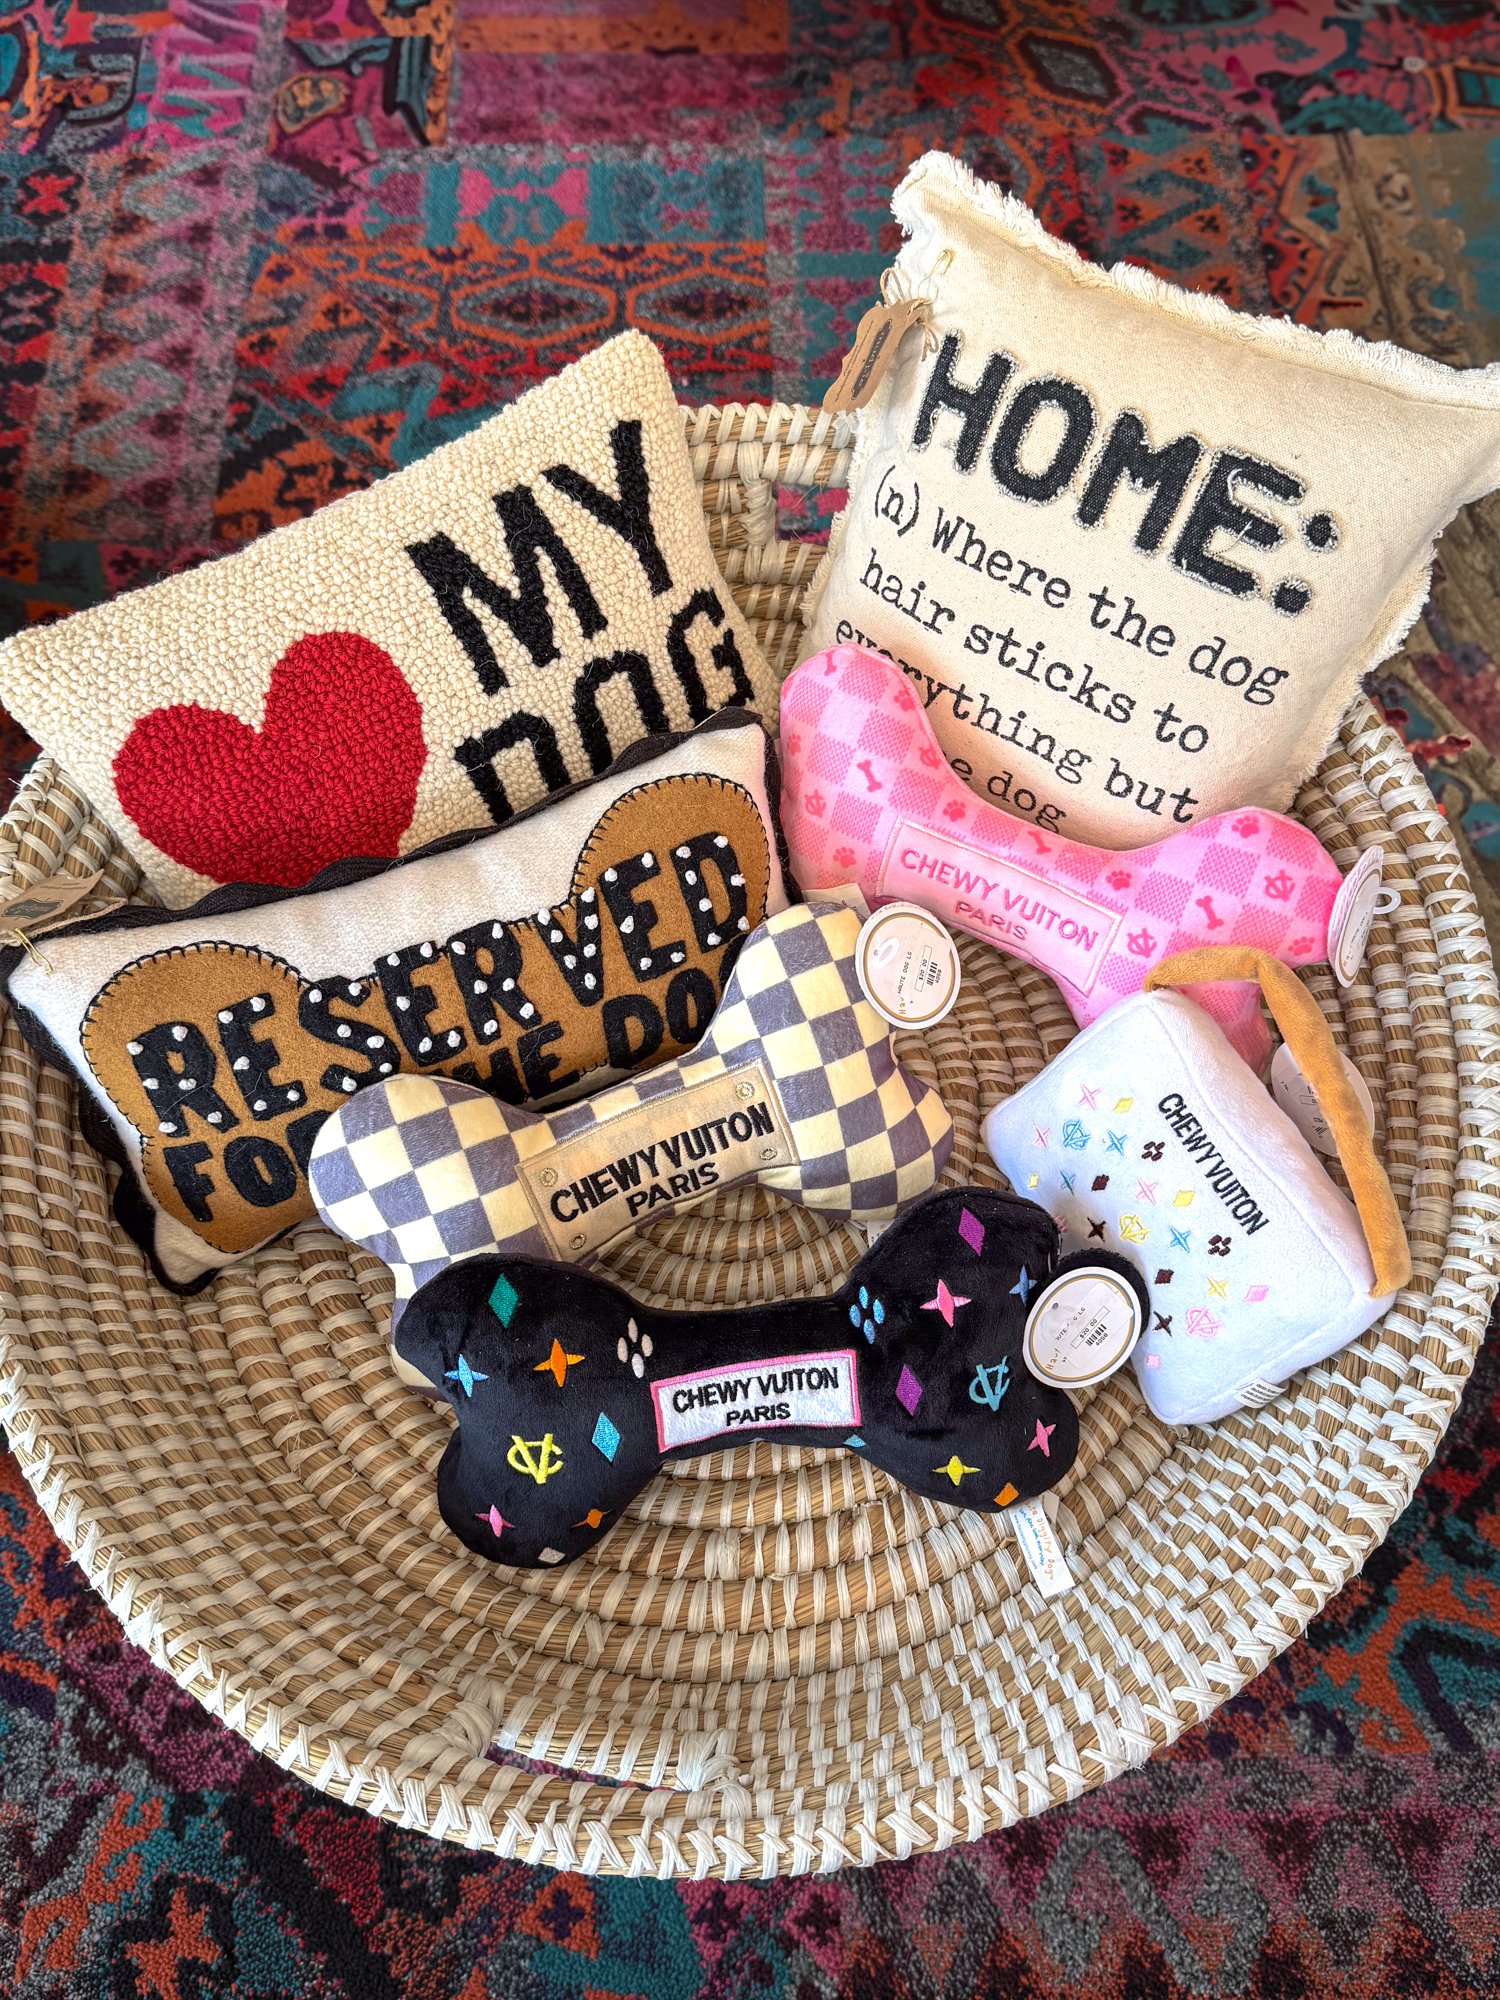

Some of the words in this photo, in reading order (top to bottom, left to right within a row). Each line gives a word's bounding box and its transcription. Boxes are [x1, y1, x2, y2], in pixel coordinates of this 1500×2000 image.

[910, 328, 1341, 617] HOME:
[404, 419, 673, 696] MY
[874, 464, 920, 537] (n)
[930, 506, 1071, 610] Where
[1088, 586, 1176, 657] the
[1188, 635, 1290, 706] dog
[859, 548, 955, 635] hair
[963, 623, 1137, 724] sticks
[1153, 702, 1210, 753] to
[987, 770, 1067, 835] dog
[1103, 757, 1200, 824] but
[900, 847, 1000, 901] CHEWY
[1003, 888, 1100, 952] VUITON
[954, 900, 1028, 941] PARIS
[127, 833, 750, 1139] RESERVED
[425, 1020, 581, 1101] HE
[602, 930, 742, 1070] DO
[625, 1162, 720, 1218] PARIS
[672, 1377, 751, 1414] CHEWY
[756, 1366, 839, 1397] VUITON
[725, 1402, 792, 1427] PARIS
